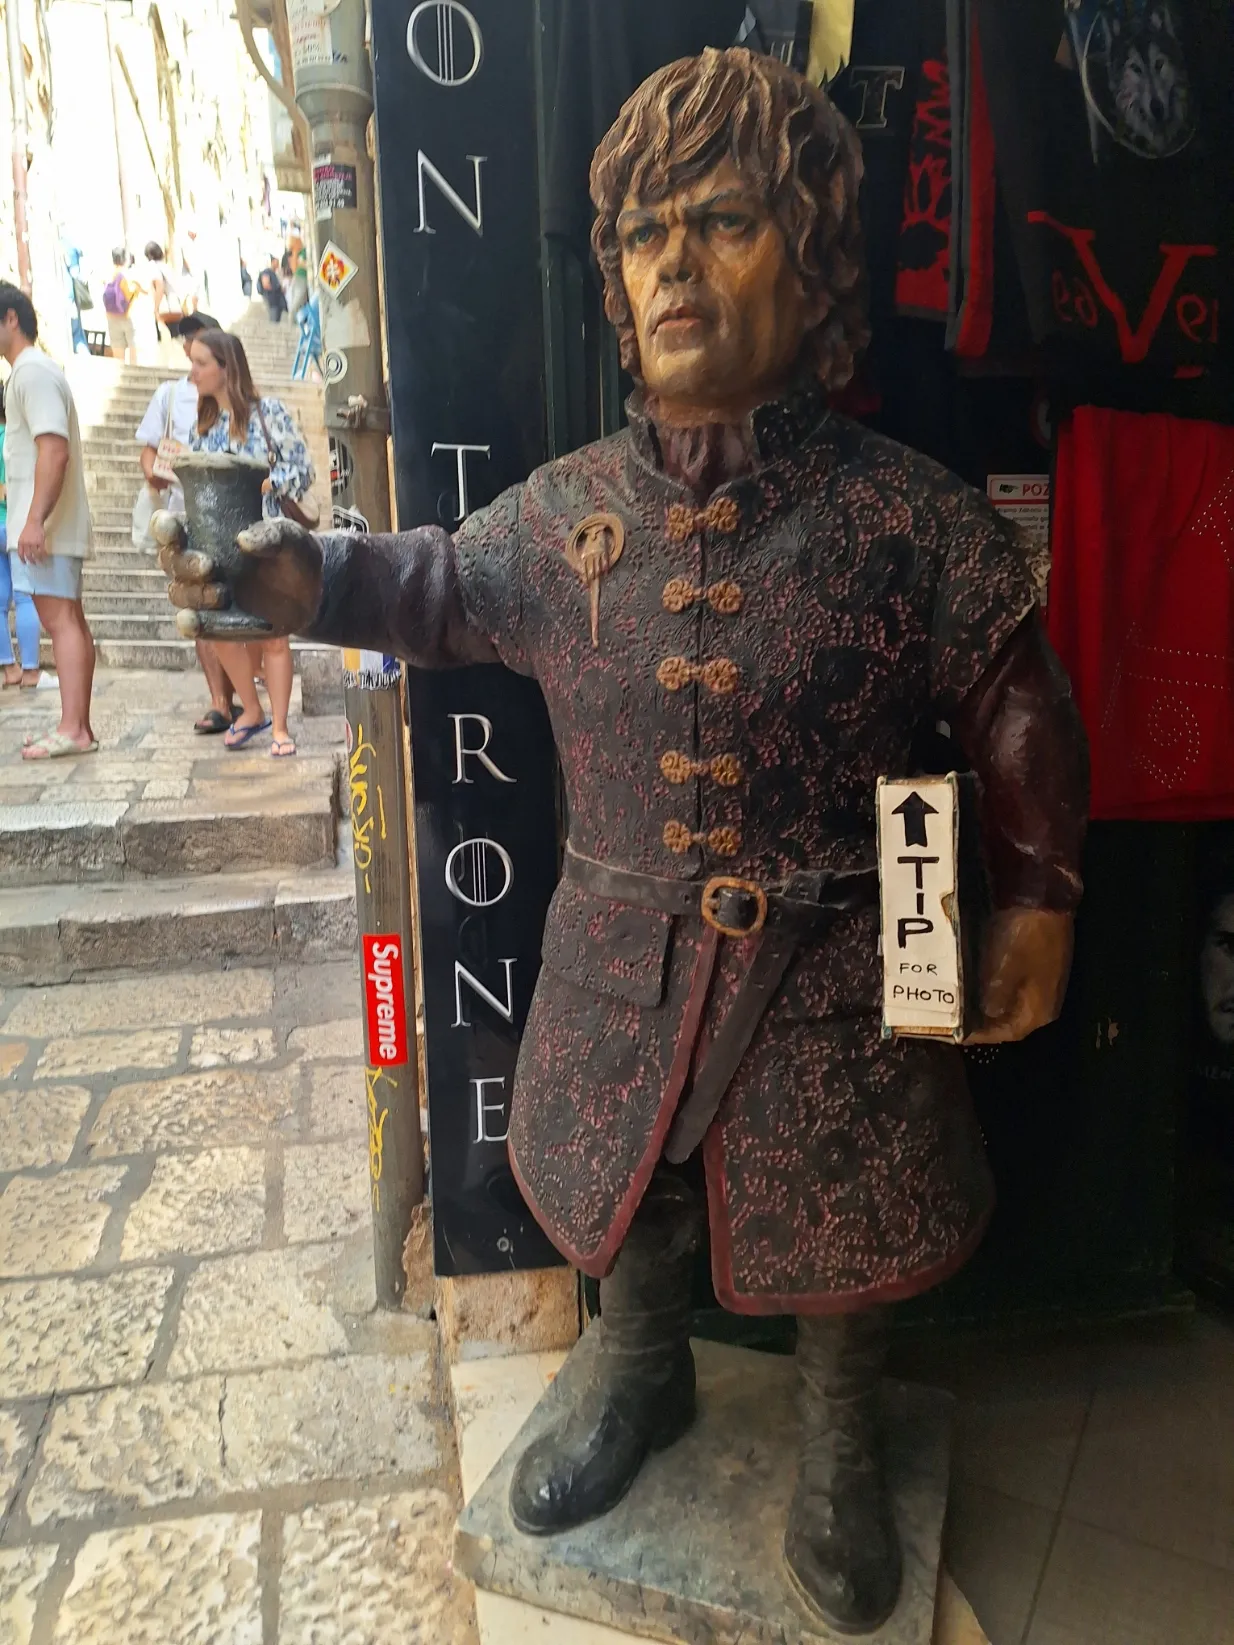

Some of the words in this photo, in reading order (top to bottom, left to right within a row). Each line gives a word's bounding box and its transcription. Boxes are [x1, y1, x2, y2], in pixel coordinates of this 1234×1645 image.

[897, 856, 940, 949] TIP
[893, 984, 956, 1004] PHOTO
[899, 962, 938, 977] FOR
[368, 942, 399, 1060] Supreme
